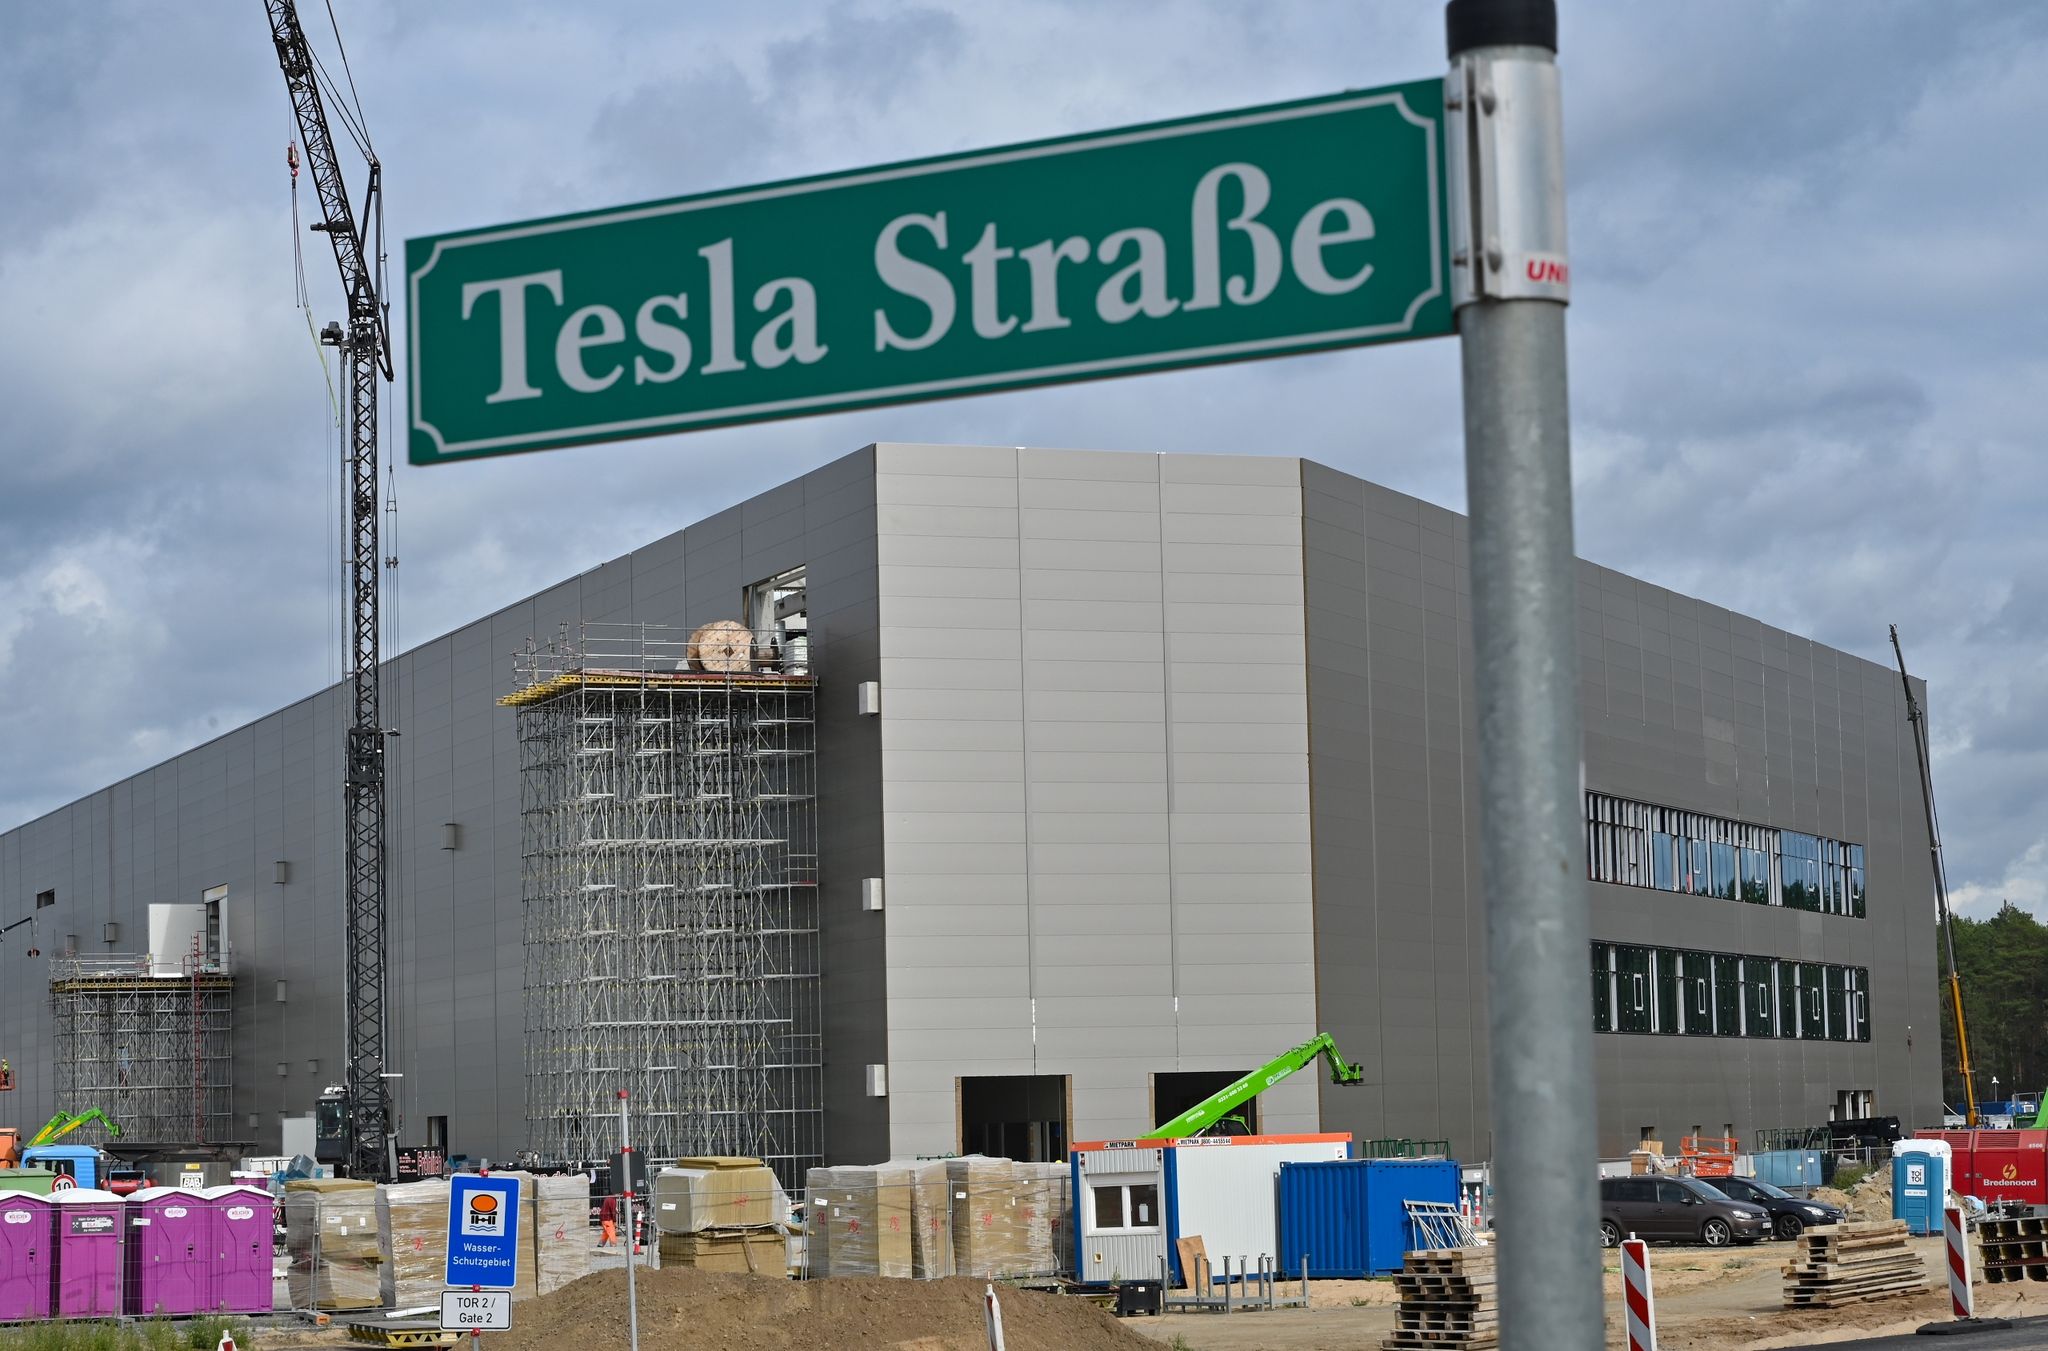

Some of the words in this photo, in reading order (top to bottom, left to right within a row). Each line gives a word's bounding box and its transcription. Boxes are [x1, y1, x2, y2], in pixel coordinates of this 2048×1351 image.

[462, 238, 829, 404] Tesla
[875, 163, 1376, 352] Straße
[1108, 1141, 1135, 1149] MIETPARK
[56, 1182, 71, 1191] 10
[183, 1177, 201, 1188] BAB
[1983, 1178, 2037, 1187] Bredenoord
[463, 1242, 502, 1254] Wasser-
[452, 1255, 511, 1269] Schutzgebiet
[457, 1297, 479, 1308] TOR
[481, 1297, 489, 1308] 2
[459, 1312, 483, 1324] Gate
[486, 1312, 493, 1324] 2
